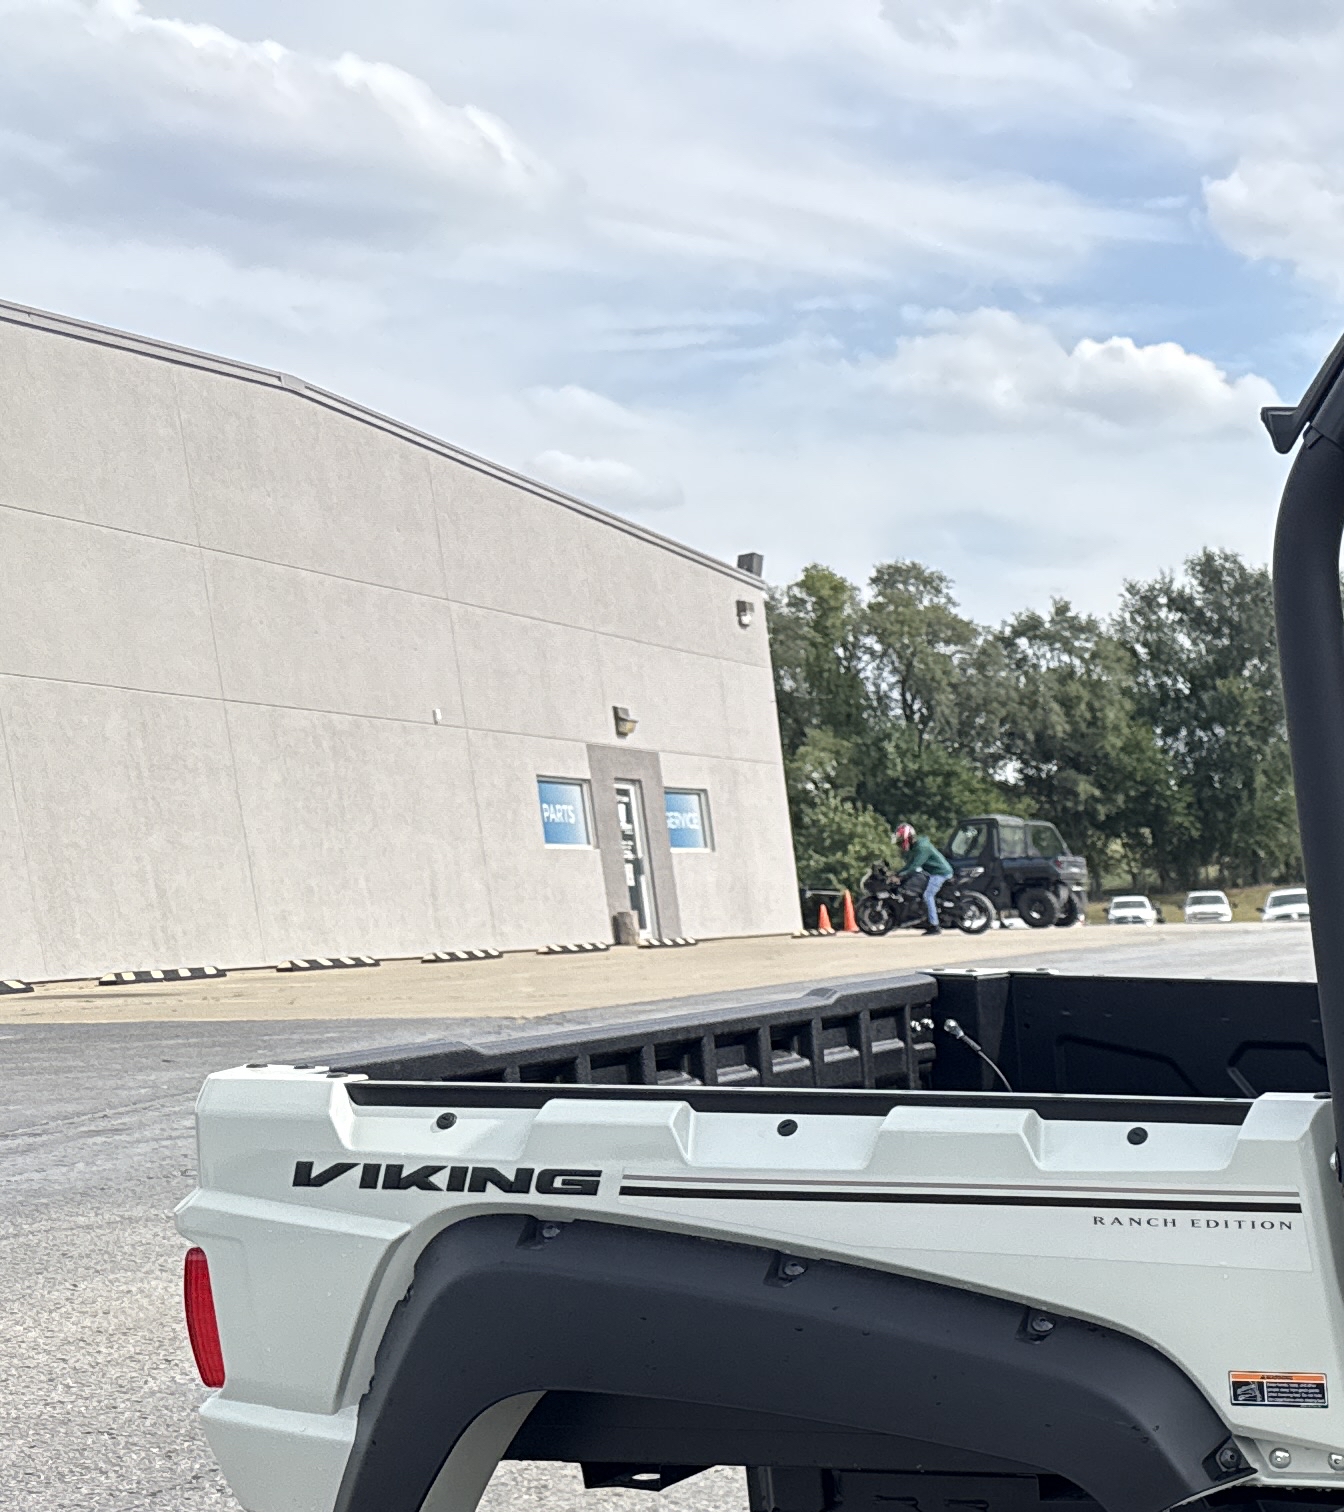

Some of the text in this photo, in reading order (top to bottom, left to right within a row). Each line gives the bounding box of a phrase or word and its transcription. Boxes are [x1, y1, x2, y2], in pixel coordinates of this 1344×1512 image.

[543, 803, 576, 825] PARTS
[292, 1161, 602, 1196] VIKING
[1094, 1216, 1293, 1231] RANCH EDITION
